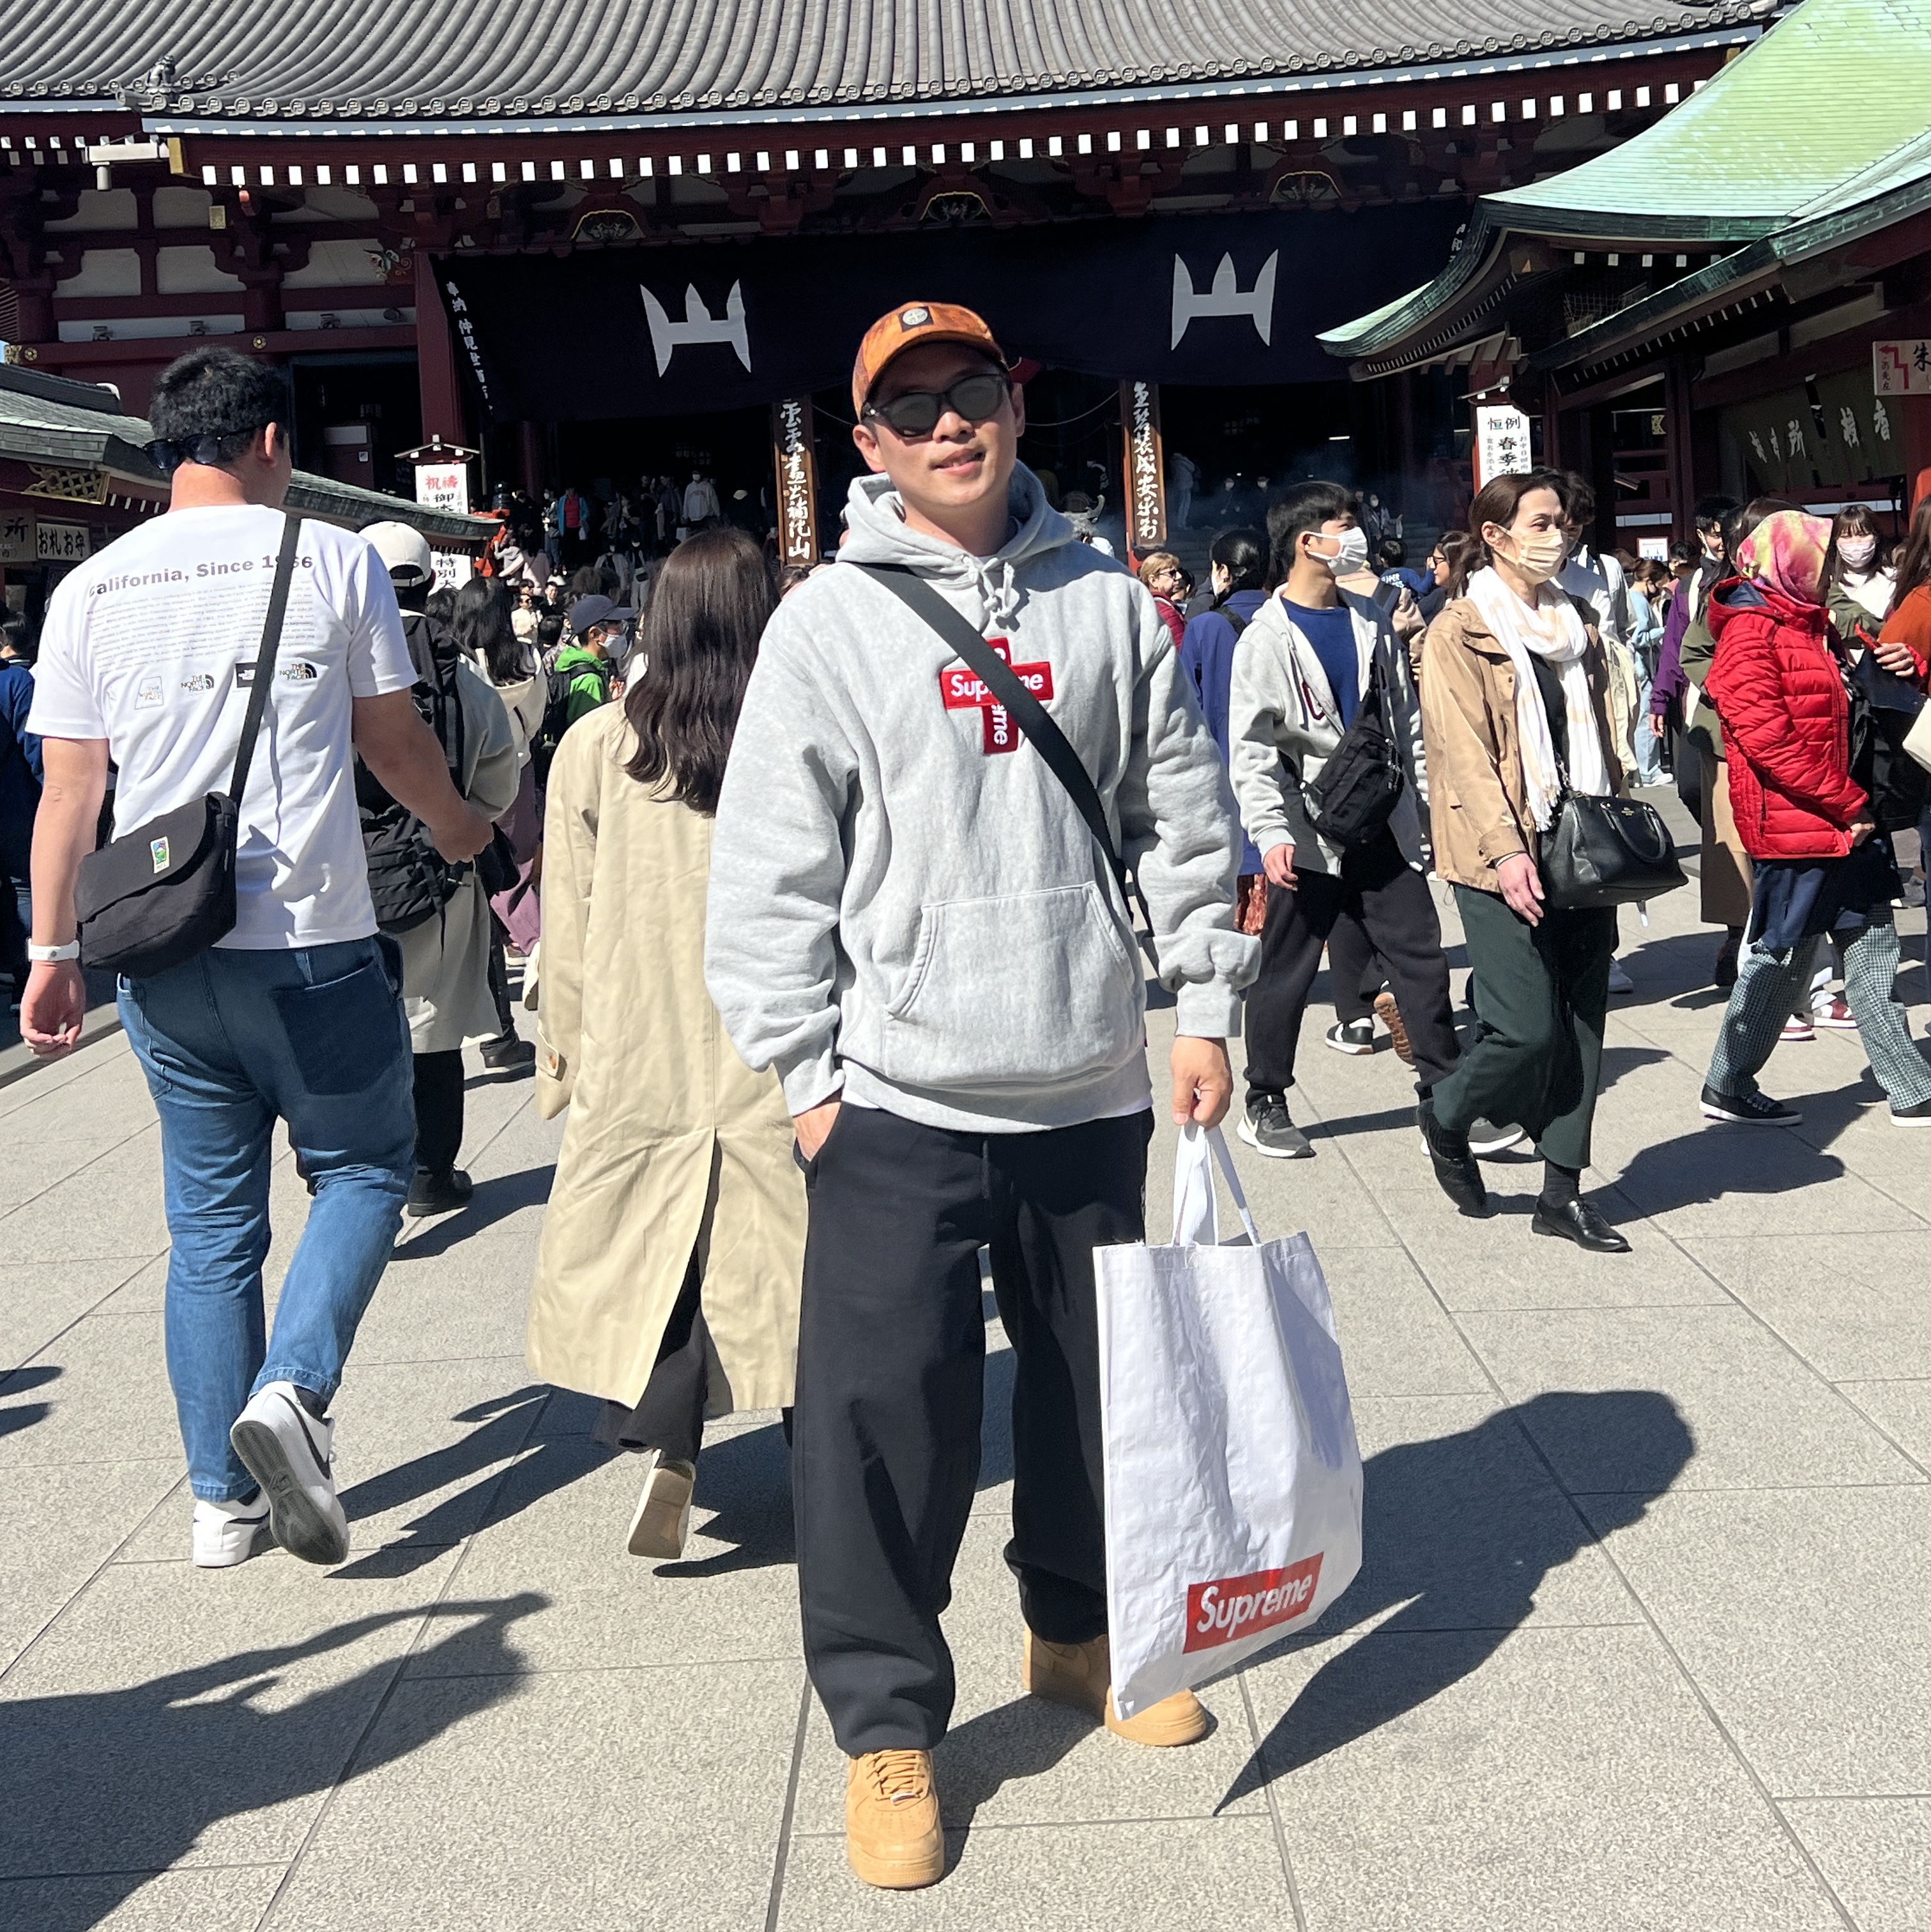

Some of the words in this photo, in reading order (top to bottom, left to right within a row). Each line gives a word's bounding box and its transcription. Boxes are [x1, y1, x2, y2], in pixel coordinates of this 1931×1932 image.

[1487, 415, 1521, 431] 恒例
[38, 527, 85, 558] お札お守
[89, 568, 190, 598] California,
[196, 559, 254, 577] Since
[261, 555, 314, 569] 166
[950, 673, 1044, 702] Supme
[1196, 1574, 1313, 1638] Supreme
